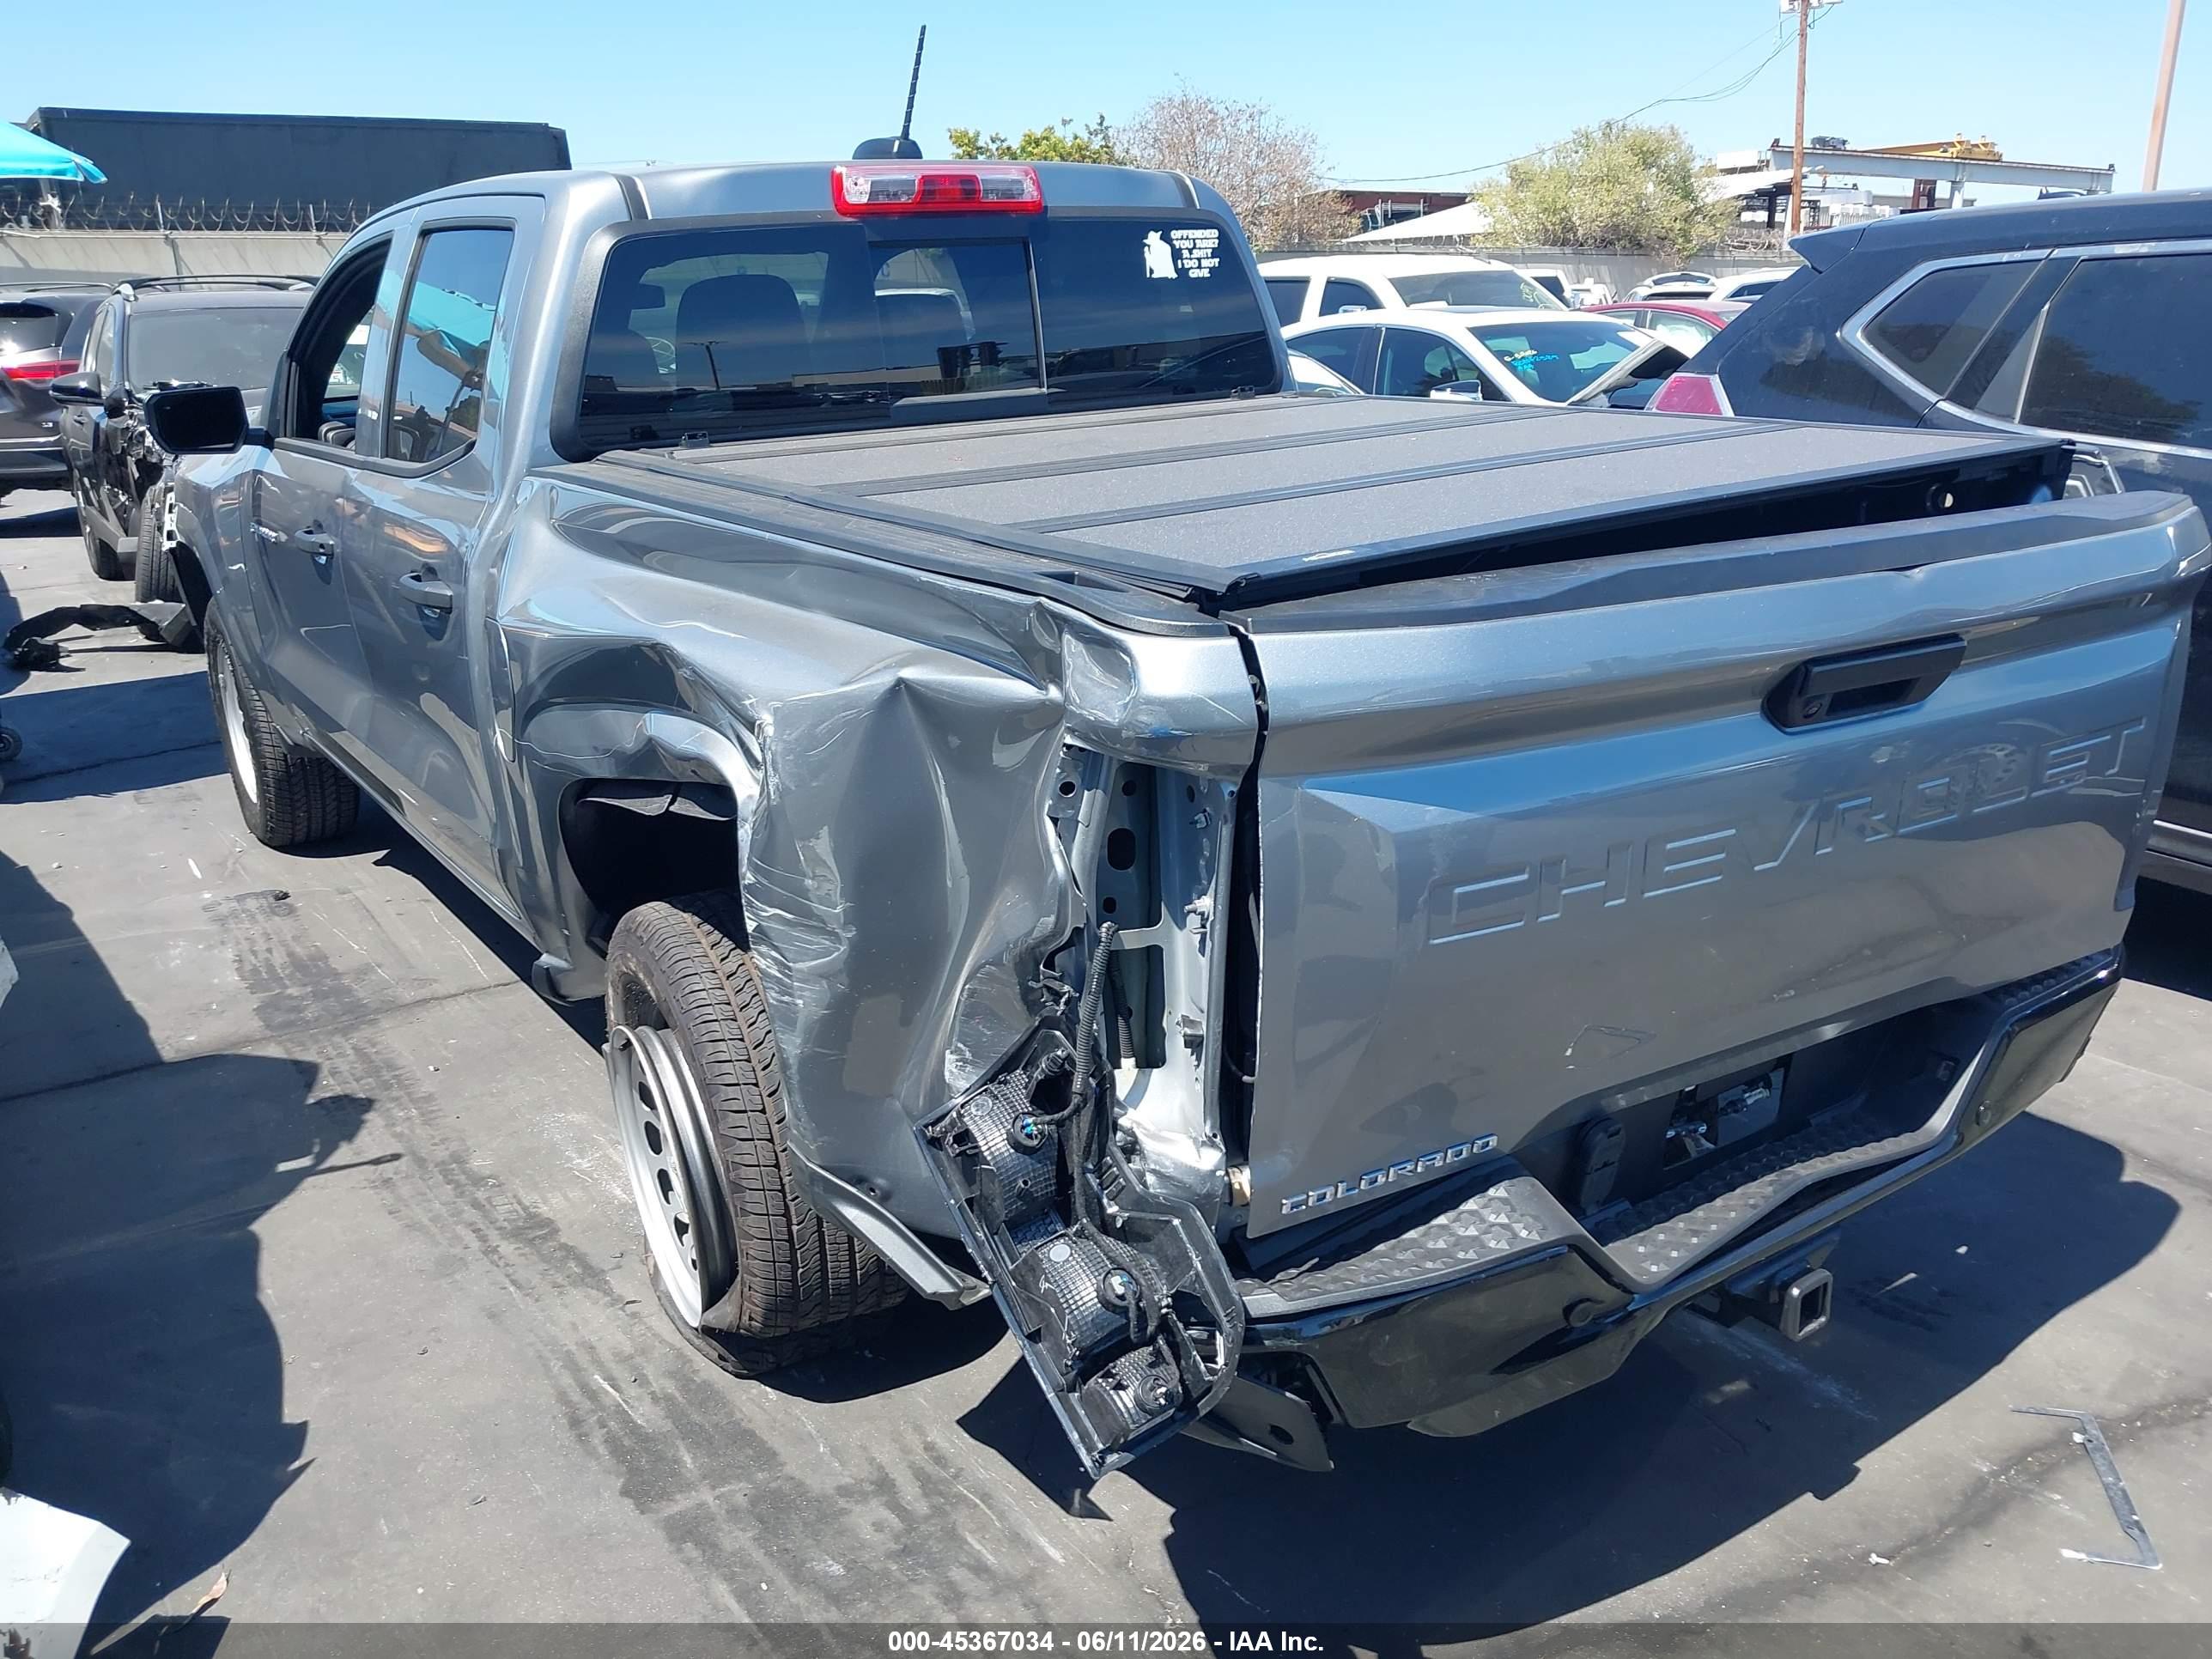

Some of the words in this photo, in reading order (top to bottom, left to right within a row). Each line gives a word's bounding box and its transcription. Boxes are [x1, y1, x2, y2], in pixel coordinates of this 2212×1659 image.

[1170, 228, 1218, 239] OFFENDED
[1173, 239, 1194, 248] YOU
[1182, 249, 1190, 258] A
[1182, 258, 1199, 268] DO
[1201, 258, 1220, 267] NOT
[1188, 268, 1211, 277] GIVE
[1429, 716, 2146, 945] CHEVROLET
[1281, 1133, 1498, 1214] COLORADO
